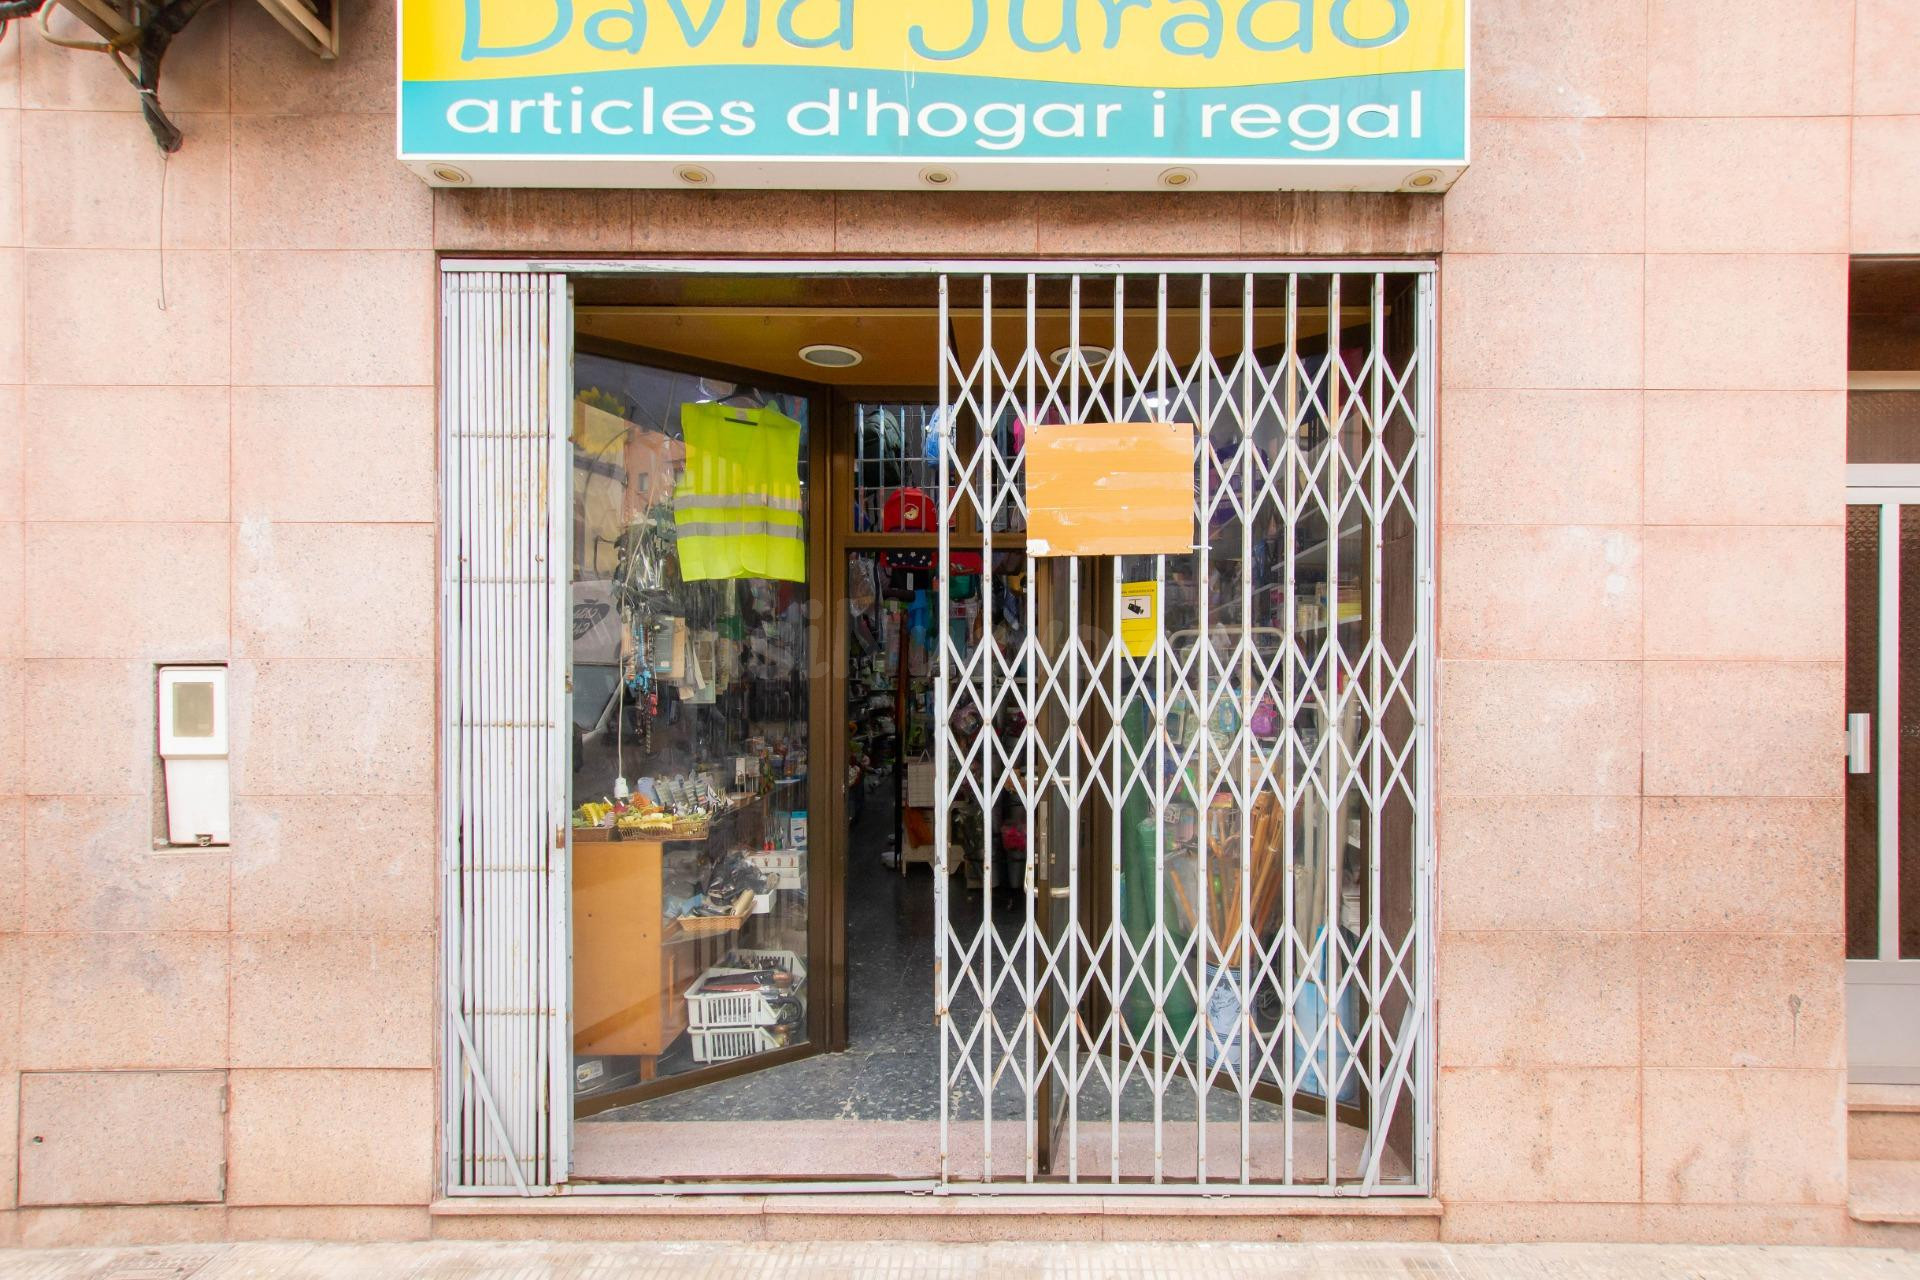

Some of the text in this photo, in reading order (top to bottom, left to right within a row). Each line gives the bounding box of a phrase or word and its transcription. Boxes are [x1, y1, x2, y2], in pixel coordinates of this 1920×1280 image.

[446, 86, 1422, 152] articles d'hogar i regal
